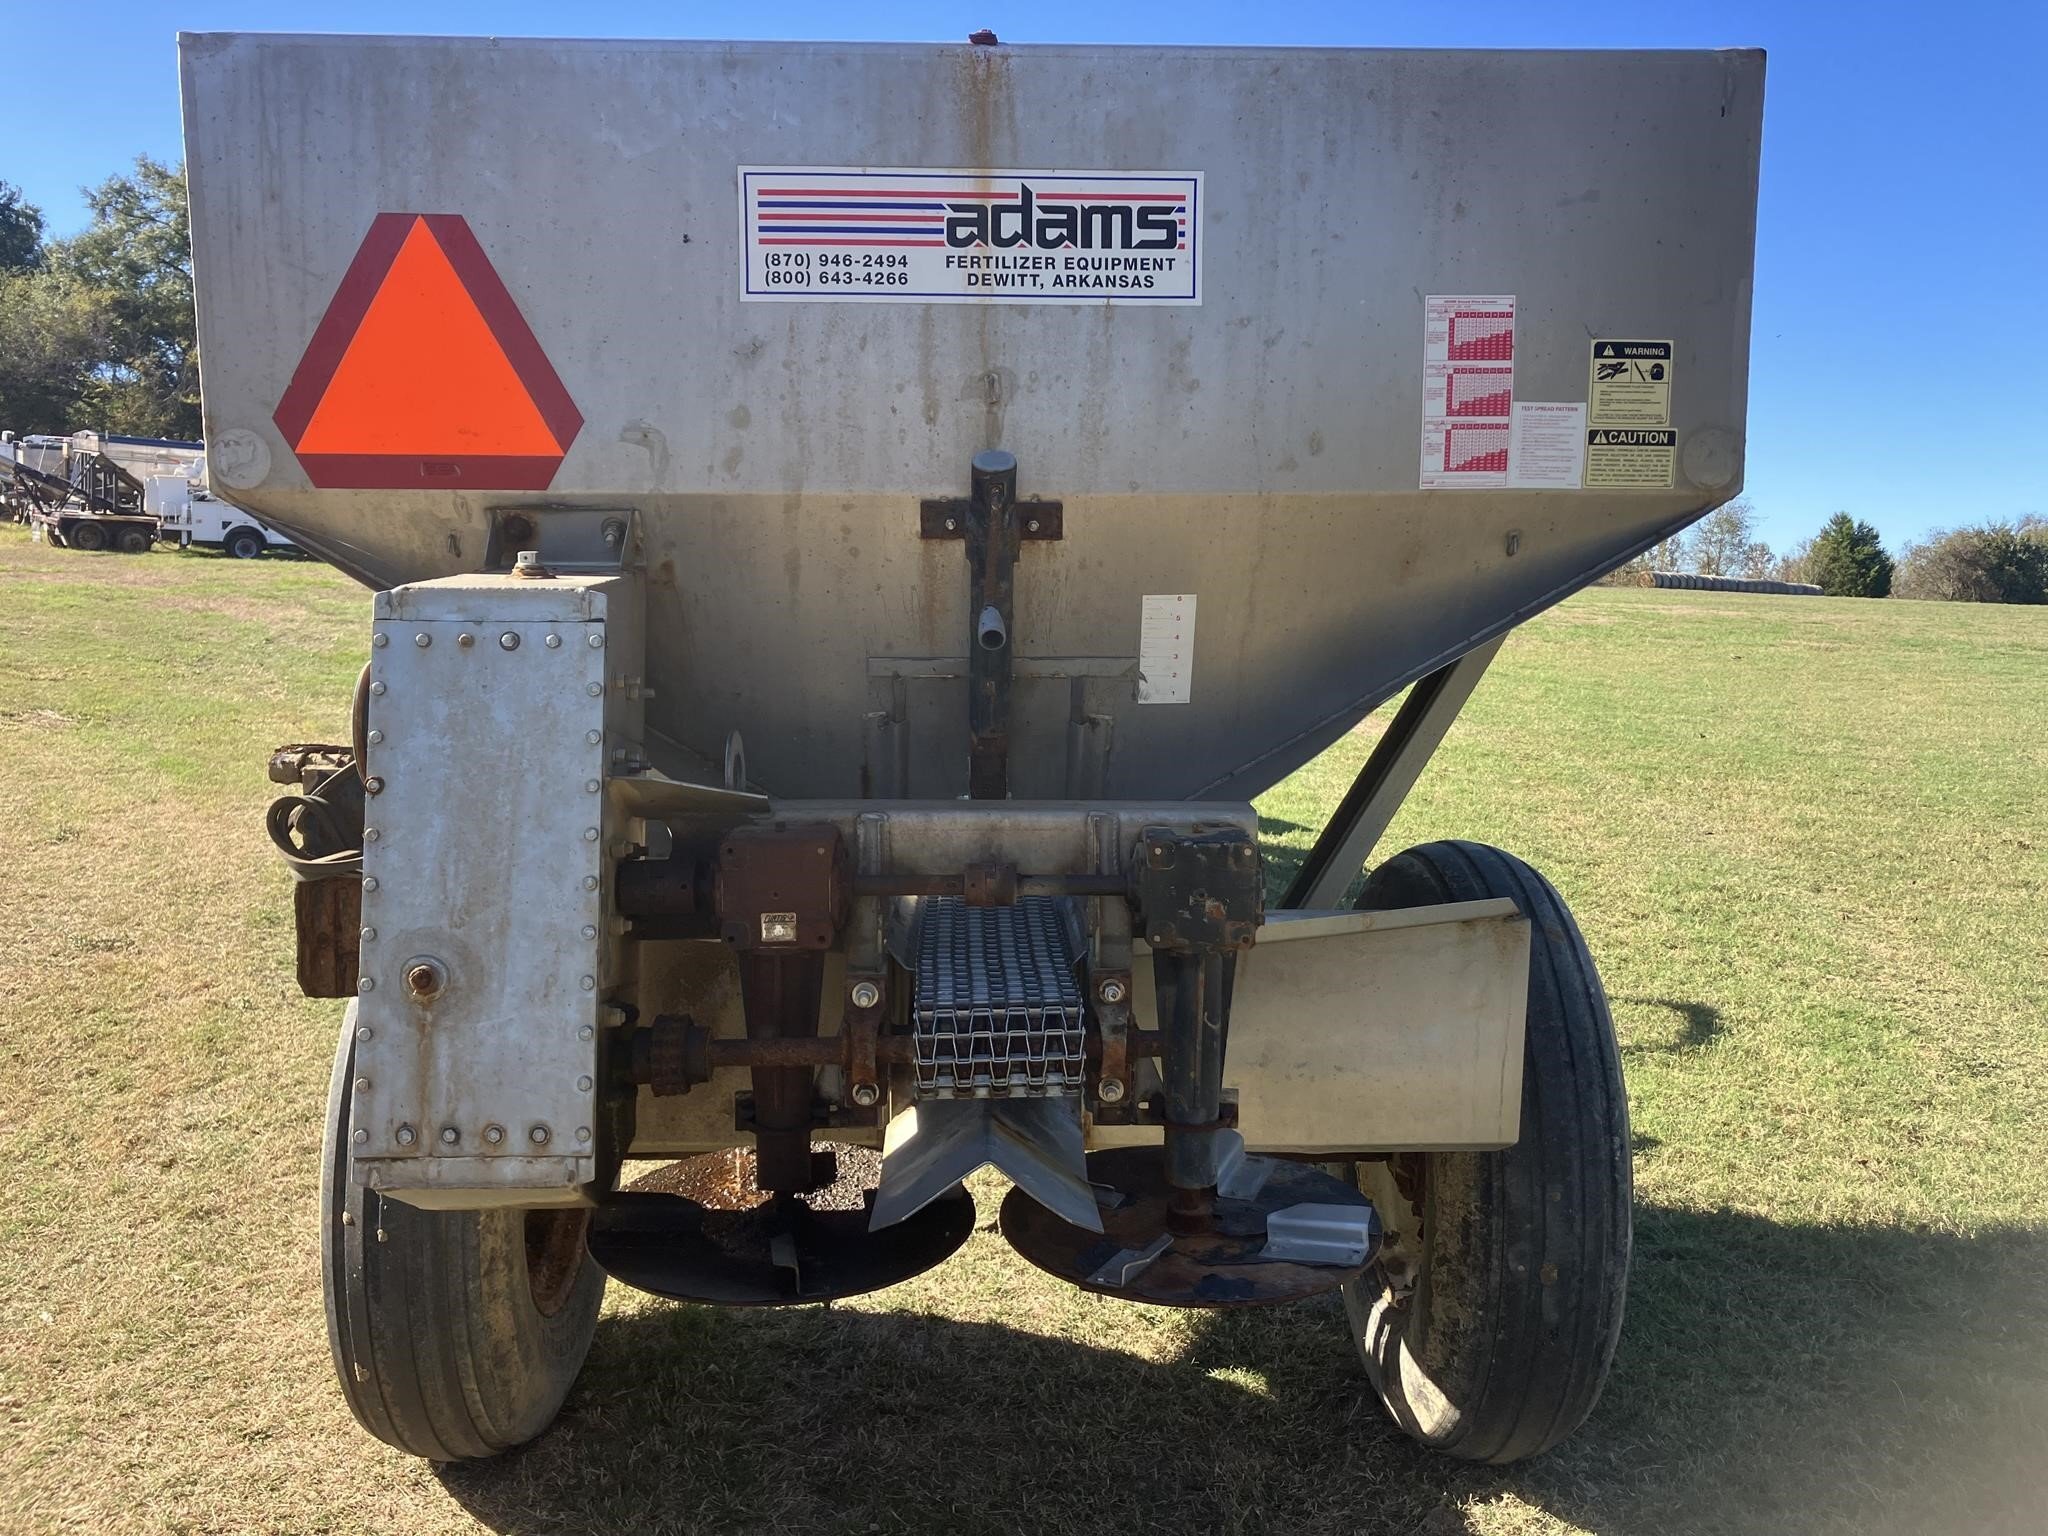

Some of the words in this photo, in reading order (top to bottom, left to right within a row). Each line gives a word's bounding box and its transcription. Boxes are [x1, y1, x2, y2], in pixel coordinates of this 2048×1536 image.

[945, 182, 1178, 249] adams
[764, 253, 812, 270] (870)
[819, 254, 909, 269] 946-2494
[945, 254, 1057, 271] FERTILIZER
[1064, 256, 1176, 272] EQUIPMENT
[764, 270, 812, 287] (800)
[819, 271, 909, 286] 643-4266
[967, 272, 1045, 290] DEWITT,
[1052, 273, 1155, 289] ARKANSAS
[1623, 347, 1665, 356] WARNING
[1534, 405, 1555, 413] SPREAD
[1608, 431, 1668, 444] CAUTION
